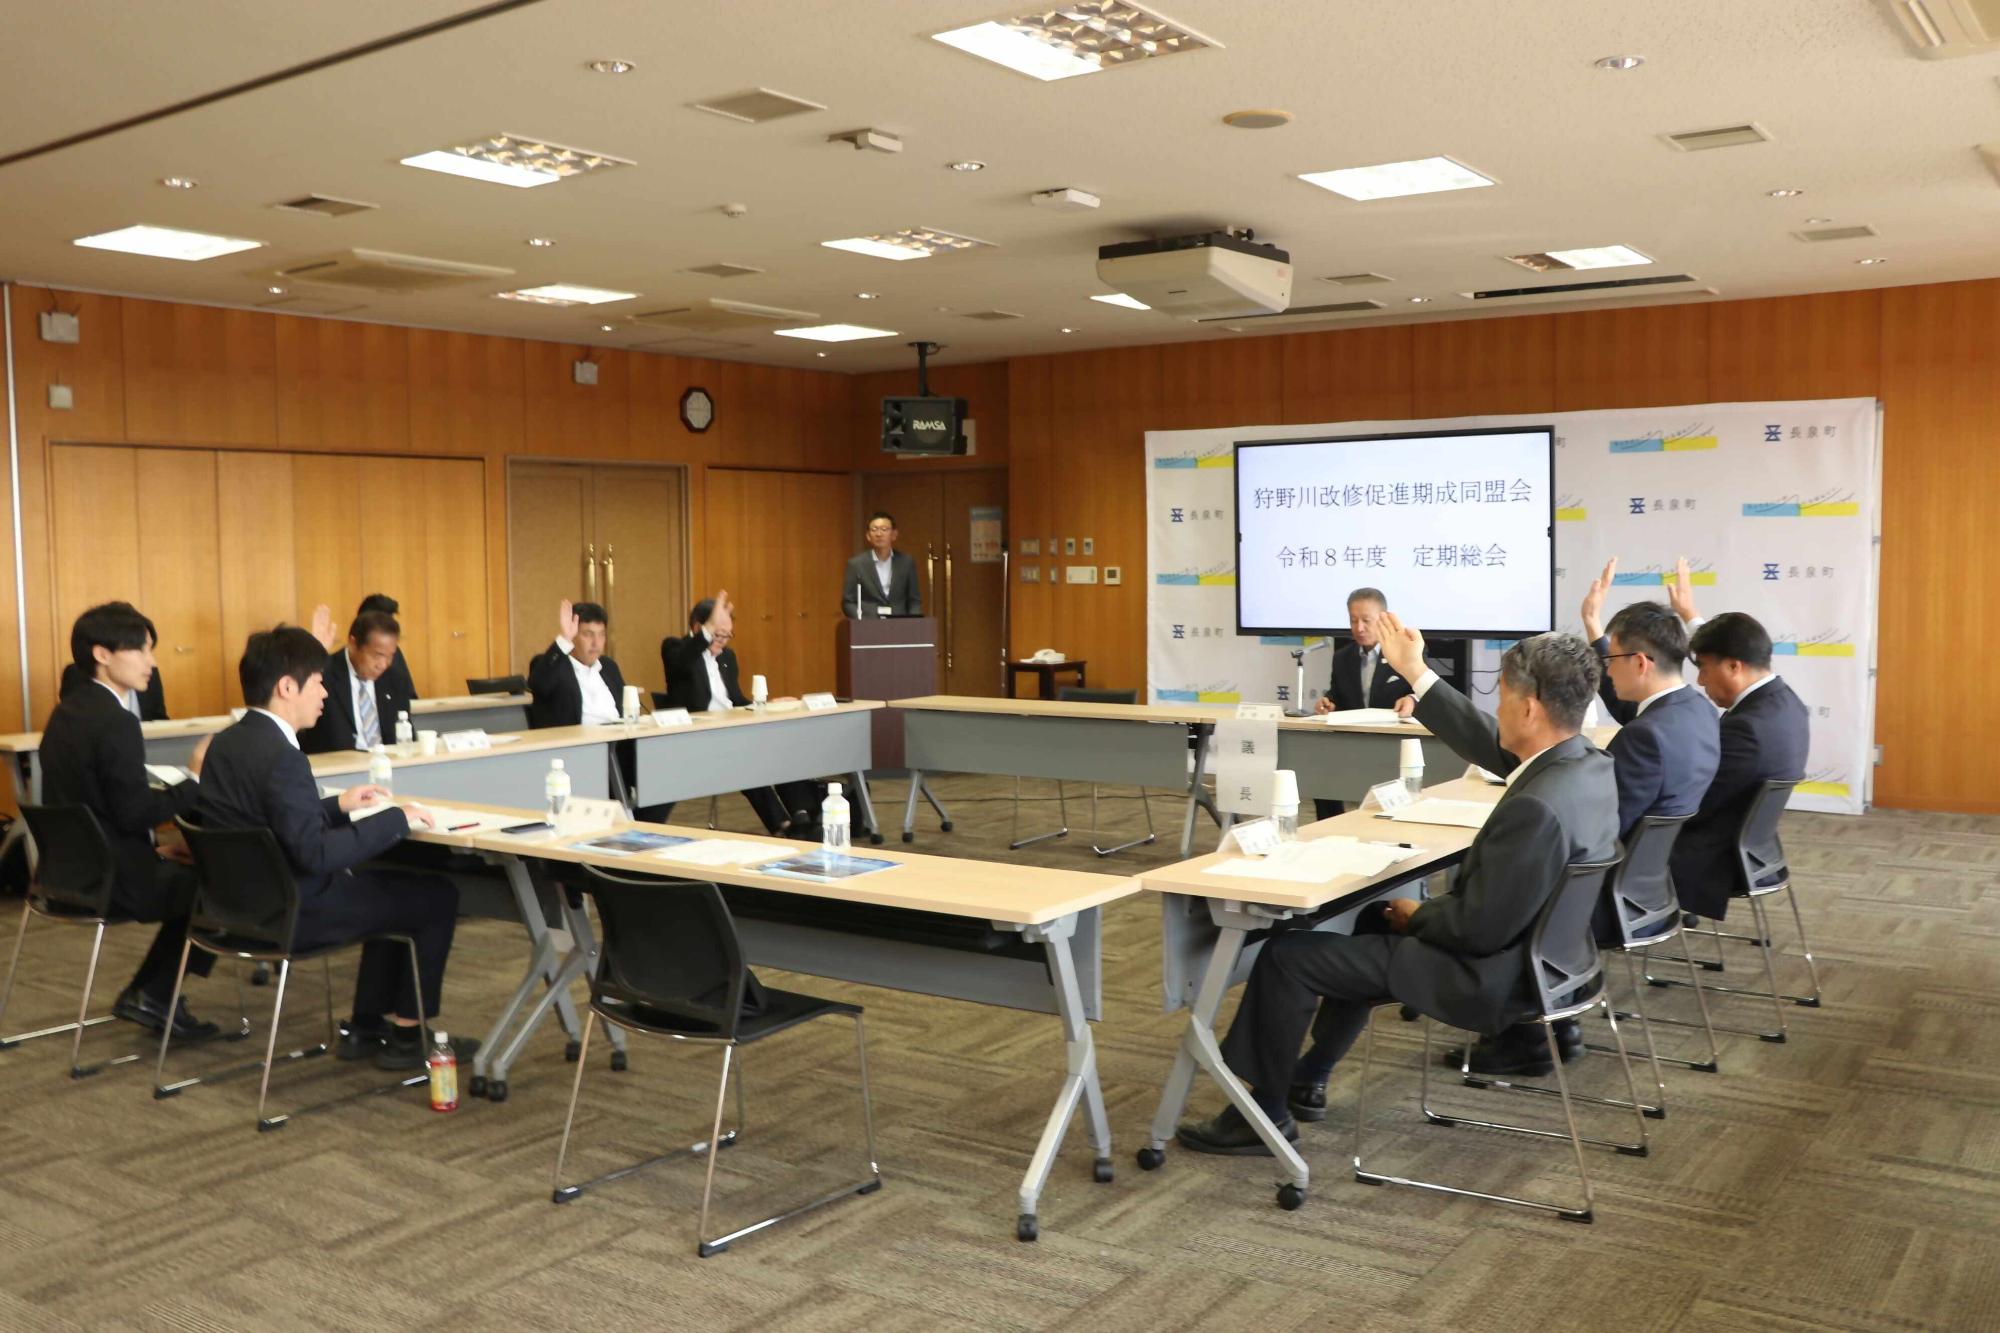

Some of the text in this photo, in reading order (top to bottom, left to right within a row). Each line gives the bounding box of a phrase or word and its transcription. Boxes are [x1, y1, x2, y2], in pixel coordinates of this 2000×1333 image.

[912, 419, 947, 431] RAMSA
[1254, 478, 1532, 509] 狩野川改修促進期成同盟会
[1276, 543, 1507, 568] 令和8年度 定期総会
